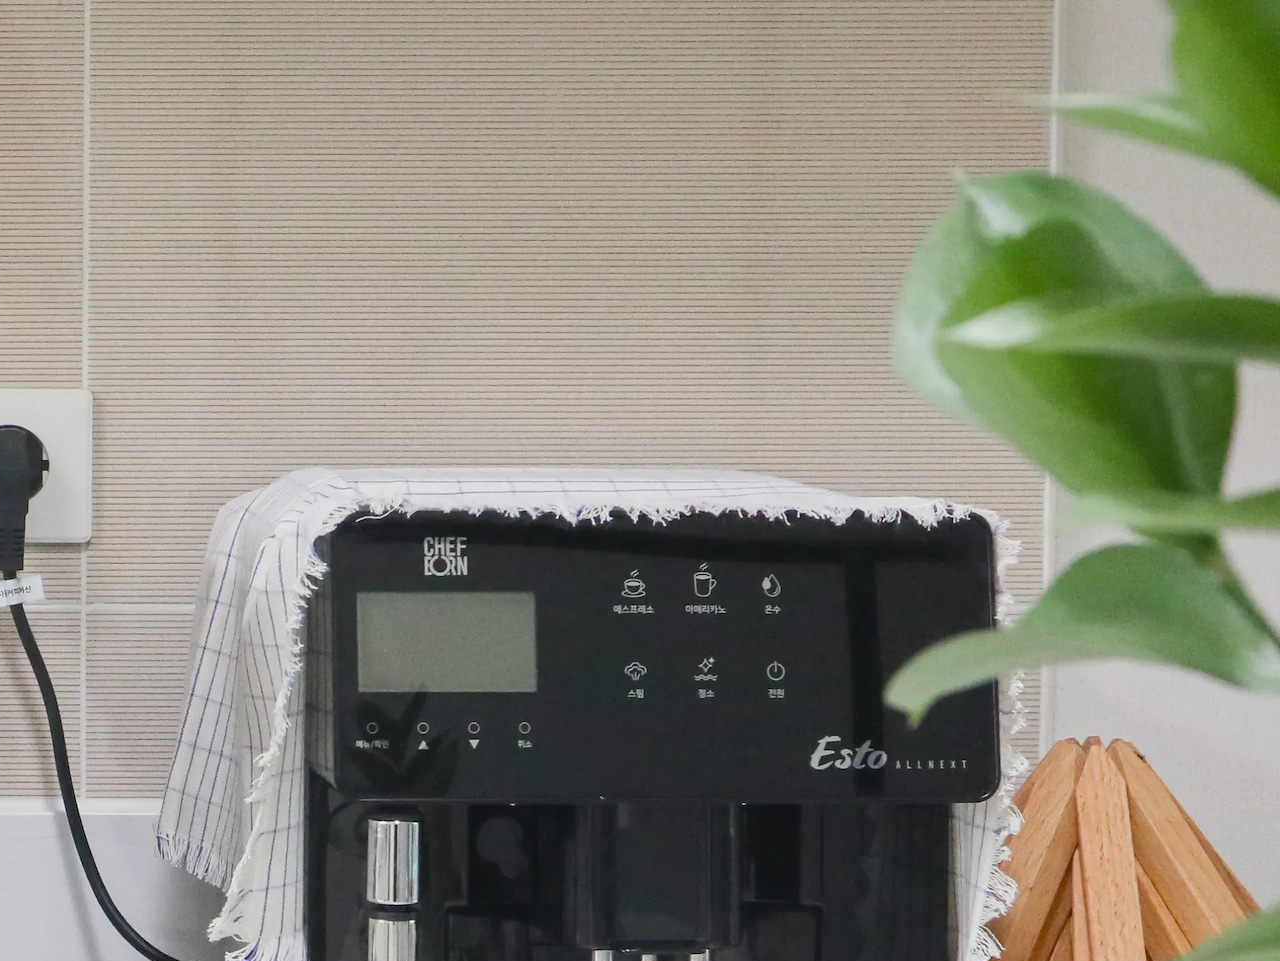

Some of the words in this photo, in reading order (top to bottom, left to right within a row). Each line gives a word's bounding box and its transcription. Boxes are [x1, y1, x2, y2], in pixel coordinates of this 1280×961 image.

[423, 537, 468, 556] CHEF
[423, 556, 468, 577] BORN
[613, 604, 655, 614] 에스프레소
[685, 604, 727, 614] 아메리카노
[764, 604, 781, 615] 온수
[627, 688, 645, 699] 스팀
[698, 688, 715, 699] 청소
[768, 688, 785, 699] 전원
[355, 739, 389, 749] 메뉴/확인
[517, 739, 533, 749] 취소
[810, 735, 888, 770] Esto
[895, 760, 969, 769] ALLNEXT
